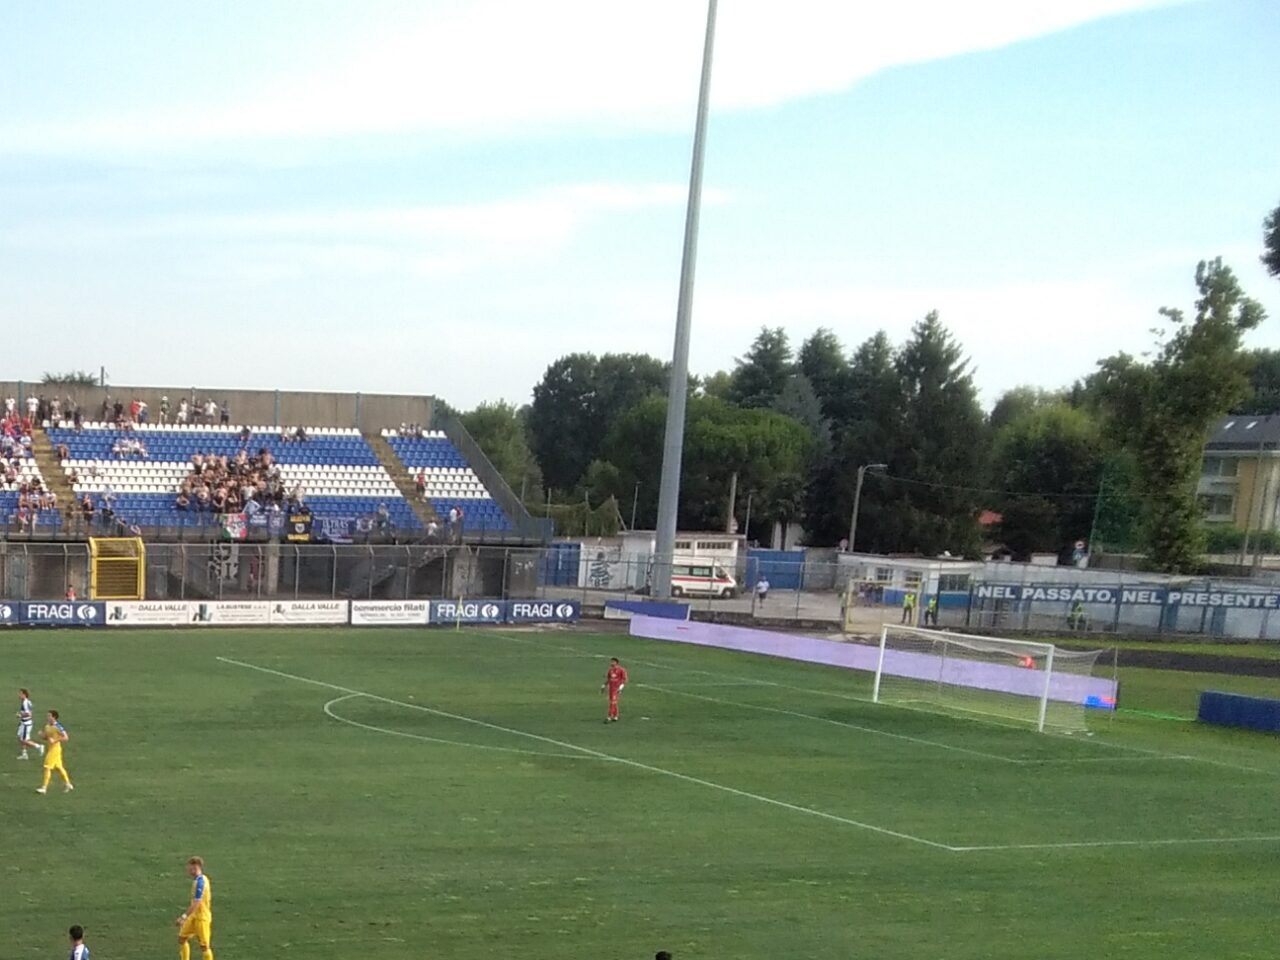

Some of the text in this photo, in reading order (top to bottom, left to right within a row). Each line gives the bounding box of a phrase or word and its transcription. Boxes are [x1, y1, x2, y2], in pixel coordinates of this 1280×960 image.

[978, 586, 1016, 599] NEL
[1022, 587, 1116, 603] PASSATO,
[1122, 590, 1162, 603] NEL
[27, 604, 73, 619] FRAGI
[437, 604, 479, 618] FRAGI
[512, 604, 553, 618] FRAGI
